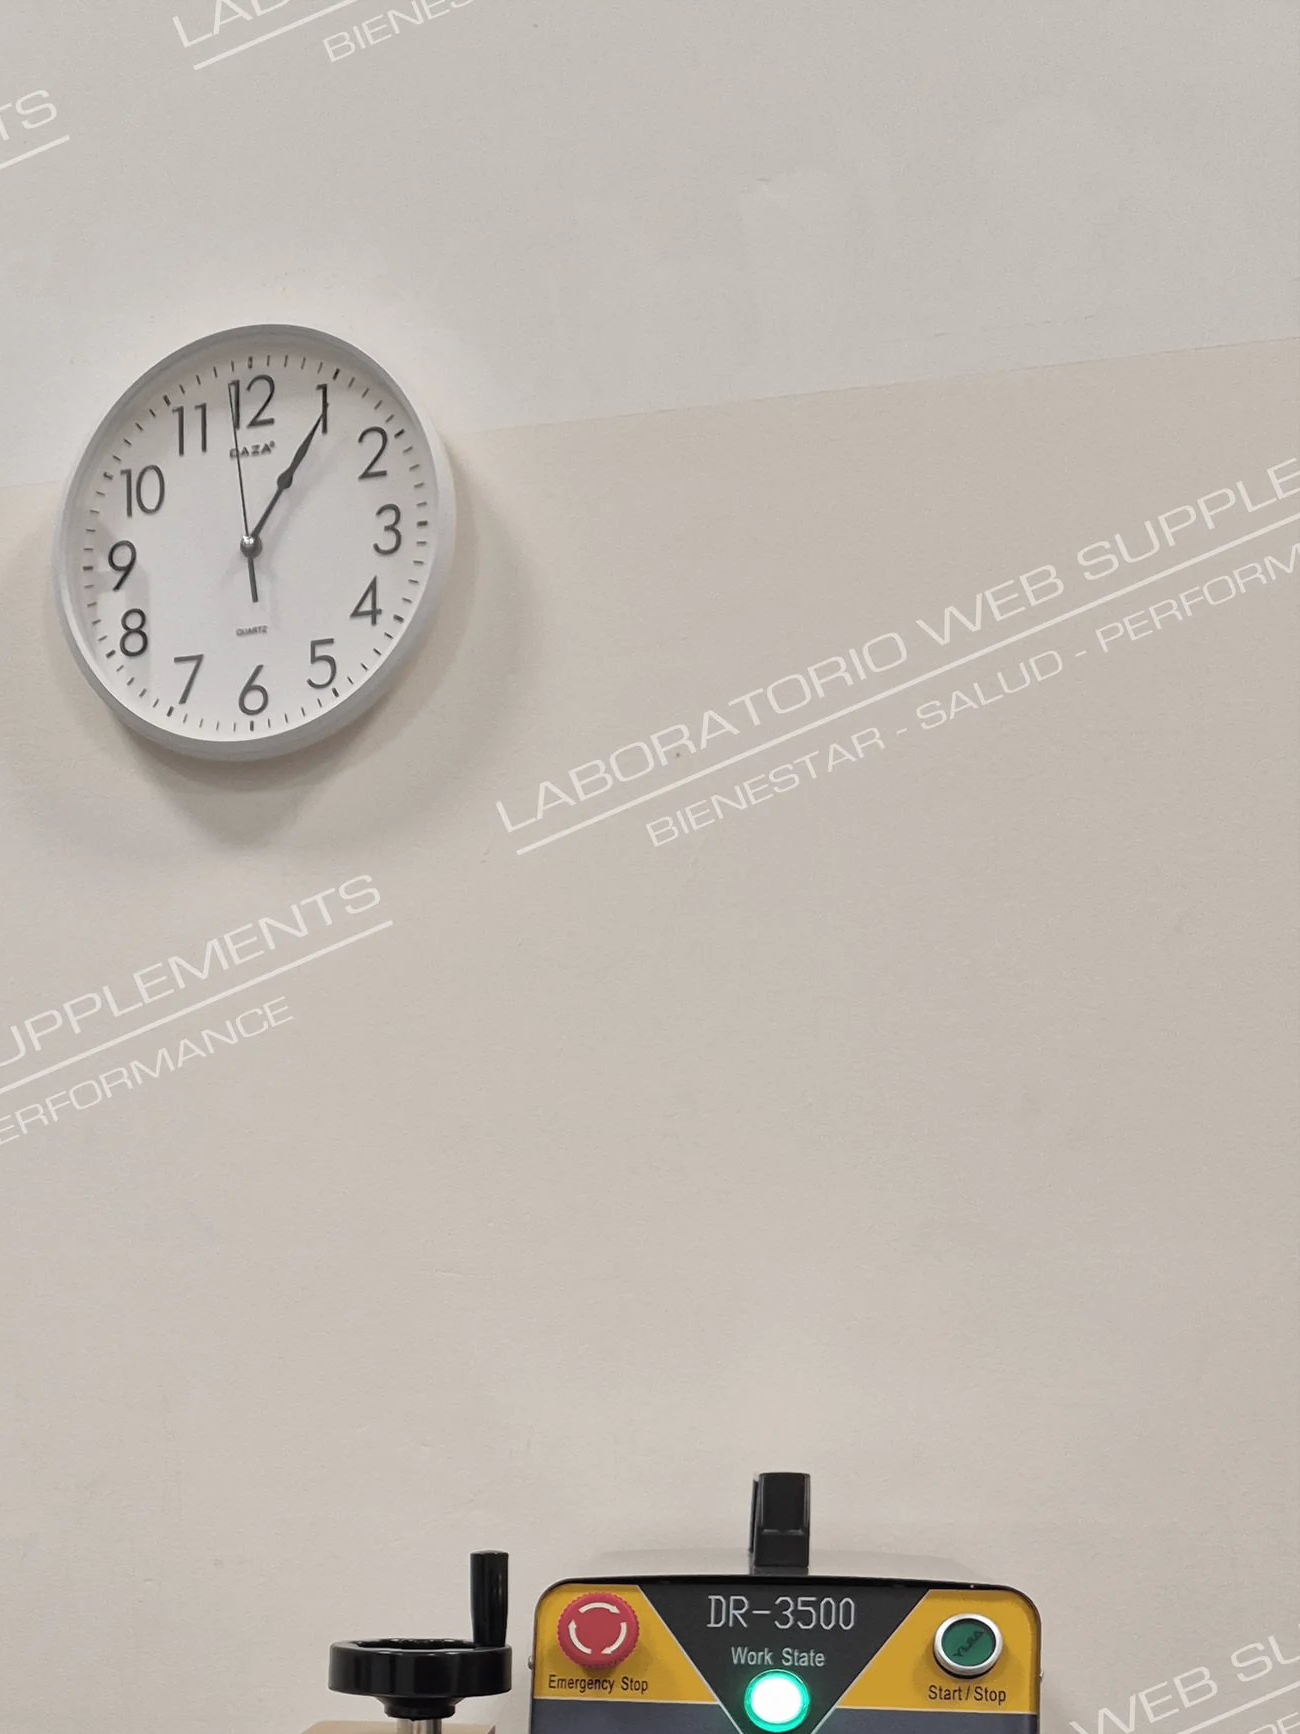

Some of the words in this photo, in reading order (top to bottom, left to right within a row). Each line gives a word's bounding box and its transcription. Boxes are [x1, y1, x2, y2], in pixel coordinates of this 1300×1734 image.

[230, 374, 274, 429] 12
[316, 383, 328, 434] 1
[172, 402, 207, 457] 11
[357, 426, 388, 480] 2
[121, 464, 165, 518] 10
[372, 503, 401, 555] 3
[107, 540, 137, 591] 9
[350, 575, 382, 626] 4
[119, 608, 148, 658] 8
[236, 625, 268, 637] QUARTZ
[173, 653, 204, 705] 7
[306, 638, 337, 690] 5
[238, 664, 269, 716] 6
[706, 1595, 855, 1630] DR-3500
[731, 1646, 773, 1665] Work
[781, 1647, 825, 1667] State
[548, 1674, 615, 1695] Emergency
[621, 1676, 649, 1693] Stop
